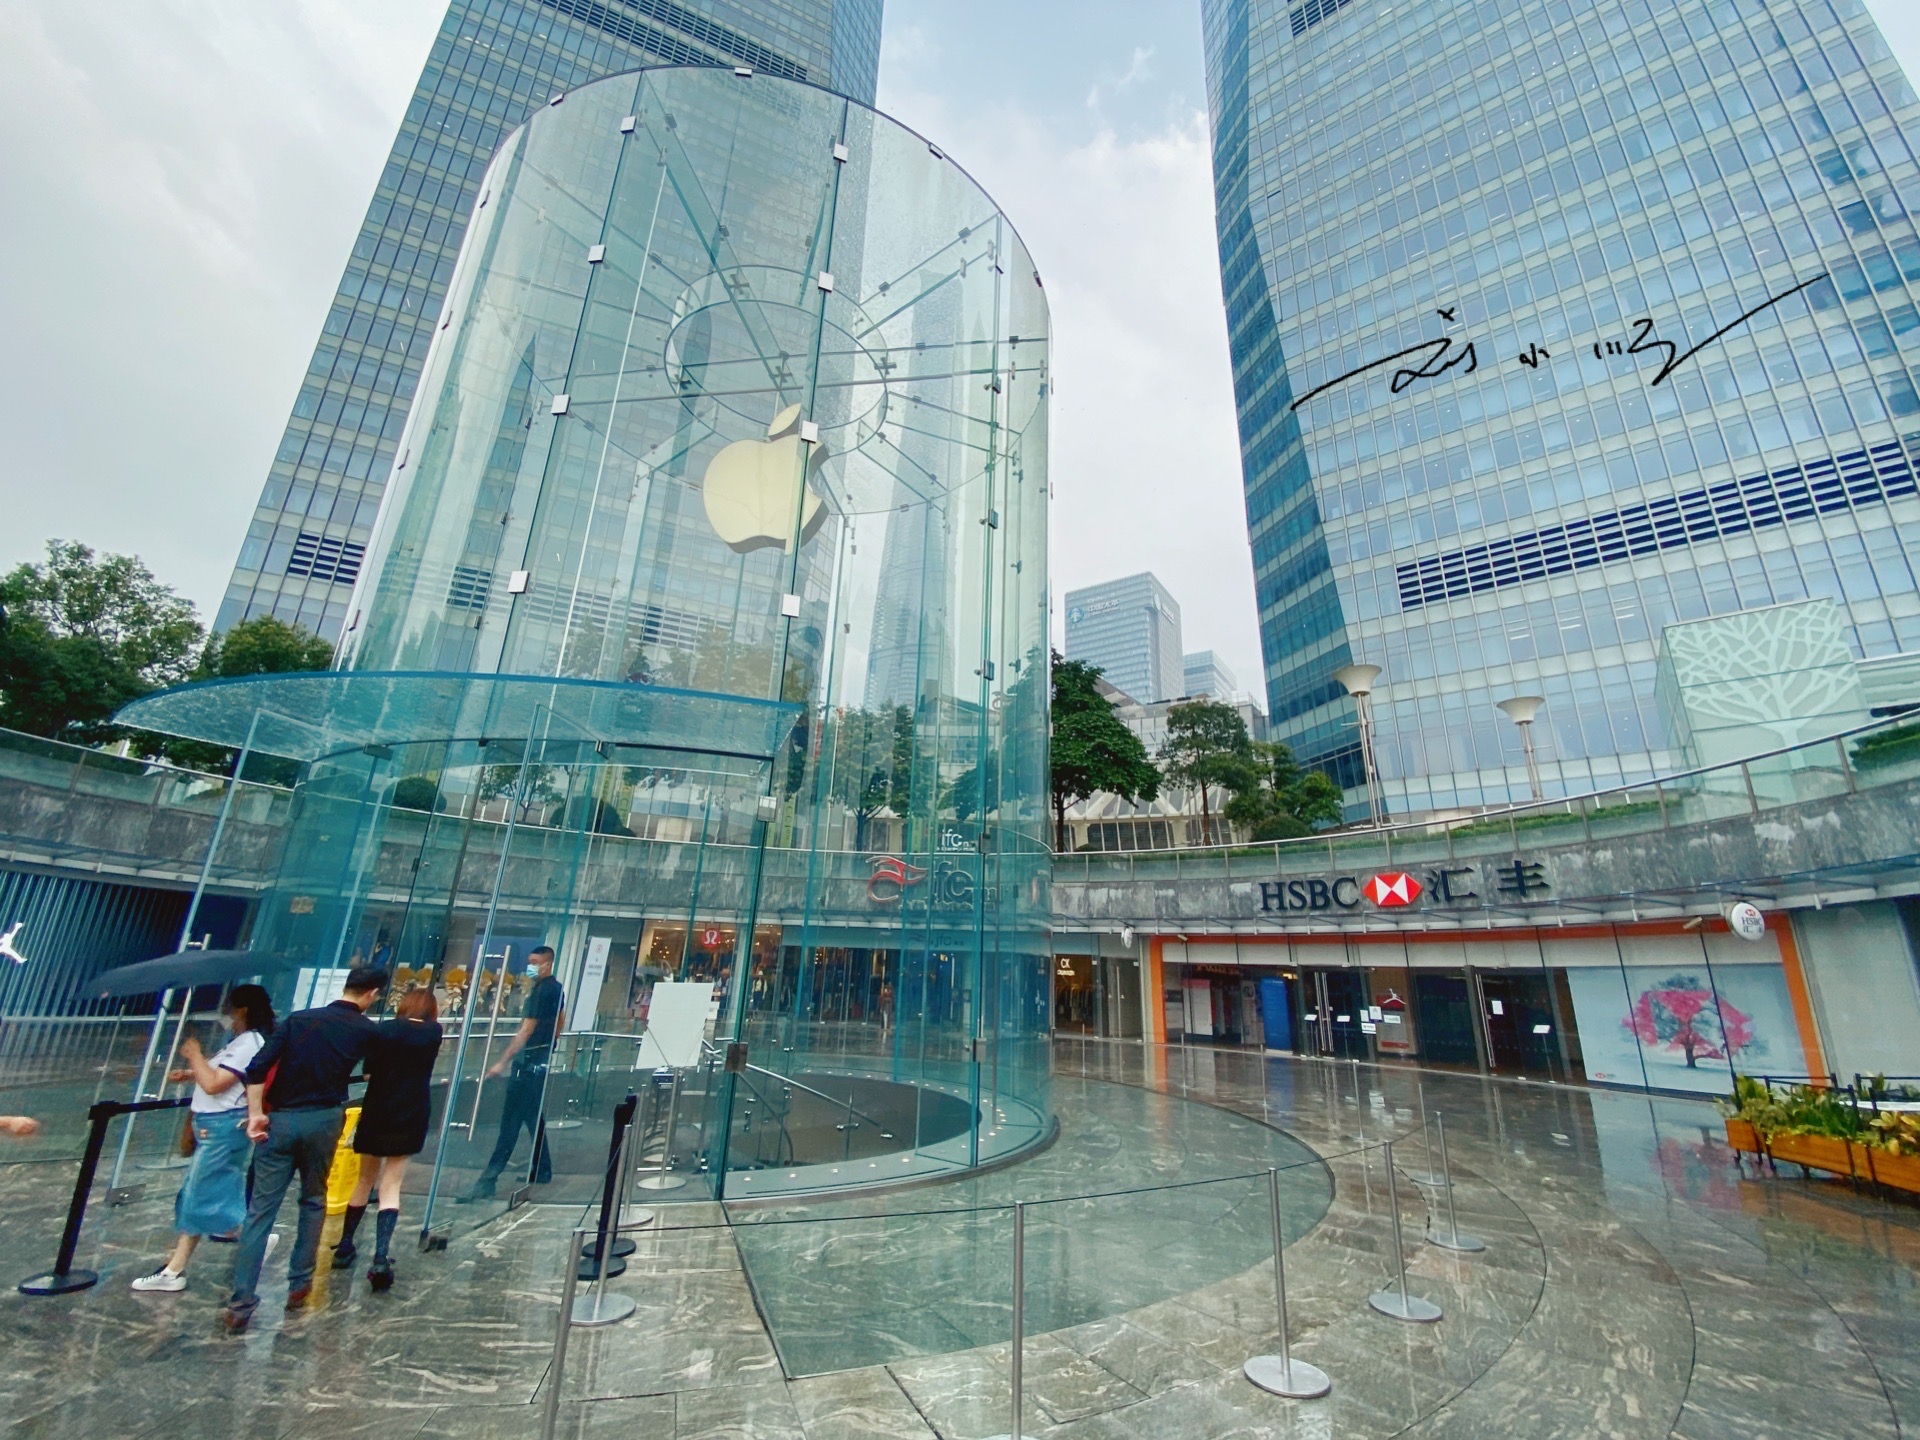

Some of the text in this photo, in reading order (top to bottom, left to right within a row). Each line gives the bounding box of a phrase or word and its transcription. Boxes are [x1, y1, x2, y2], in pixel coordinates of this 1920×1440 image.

[1258, 860, 1551, 911] HSBC 汇丰
[1741, 917, 1762, 926] HSBC
